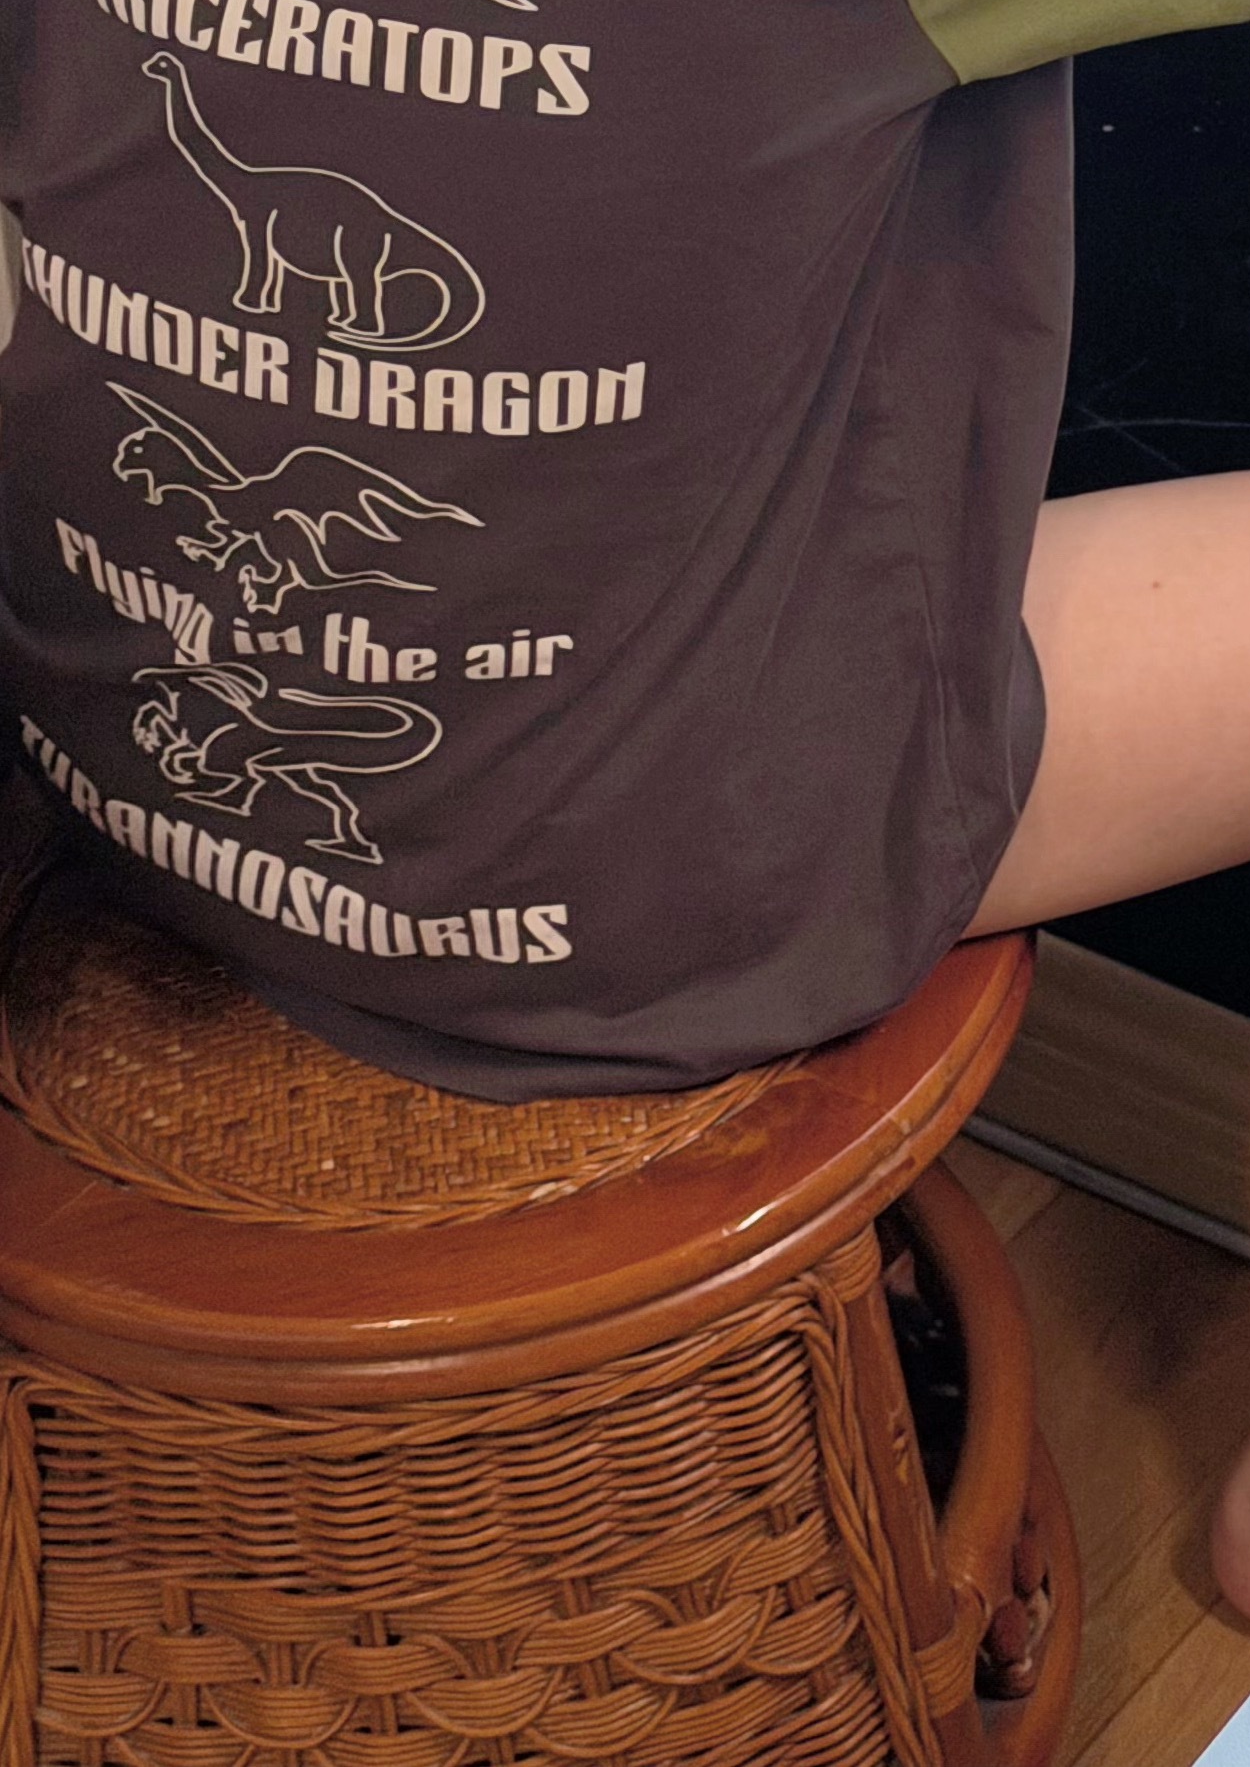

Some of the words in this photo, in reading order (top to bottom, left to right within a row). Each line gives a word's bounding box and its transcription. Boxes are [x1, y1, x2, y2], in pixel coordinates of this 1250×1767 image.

[315, 346, 646, 437] DRAGON
[56, 517, 214, 665] Flying
[233, 616, 304, 655] in
[324, 612, 438, 684] the
[464, 629, 575, 680] air
